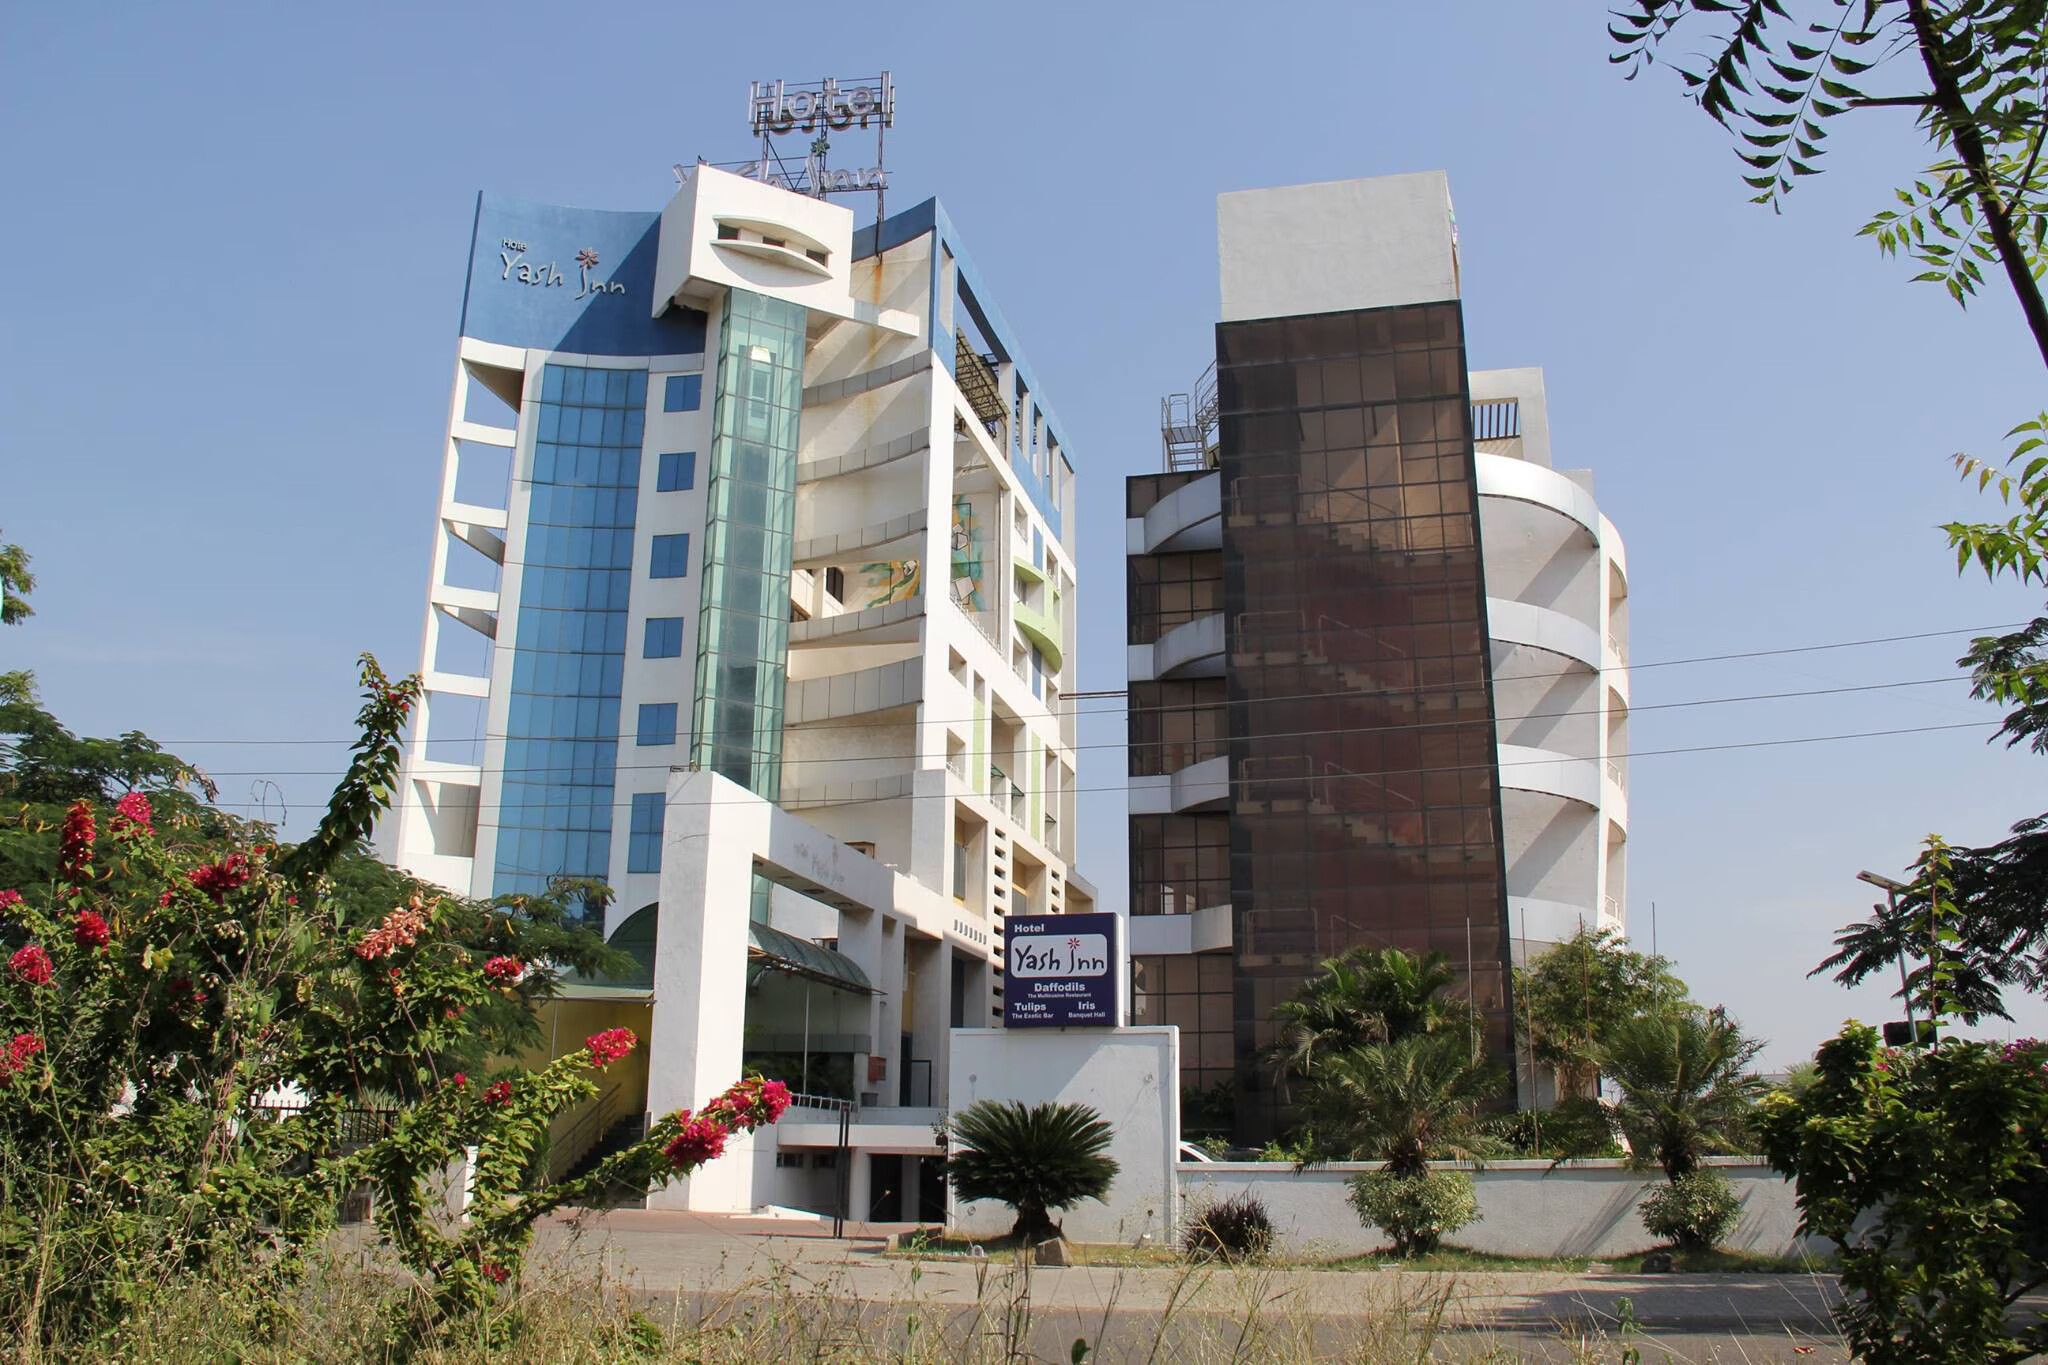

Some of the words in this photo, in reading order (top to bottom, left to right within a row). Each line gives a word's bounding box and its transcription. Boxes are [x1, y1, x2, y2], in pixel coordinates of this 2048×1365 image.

[750, 71, 891, 123] Hotel
[501, 252, 565, 288] Yash
[1014, 923, 1045, 933] Hotel
[1014, 944, 1061, 972] Yash
[1034, 982, 1086, 992] Daffodils
[1014, 1002, 1047, 1012] Tulips
[1078, 1001, 1096, 1010] Iris
[1068, 1011, 1093, 1019] Banquet
